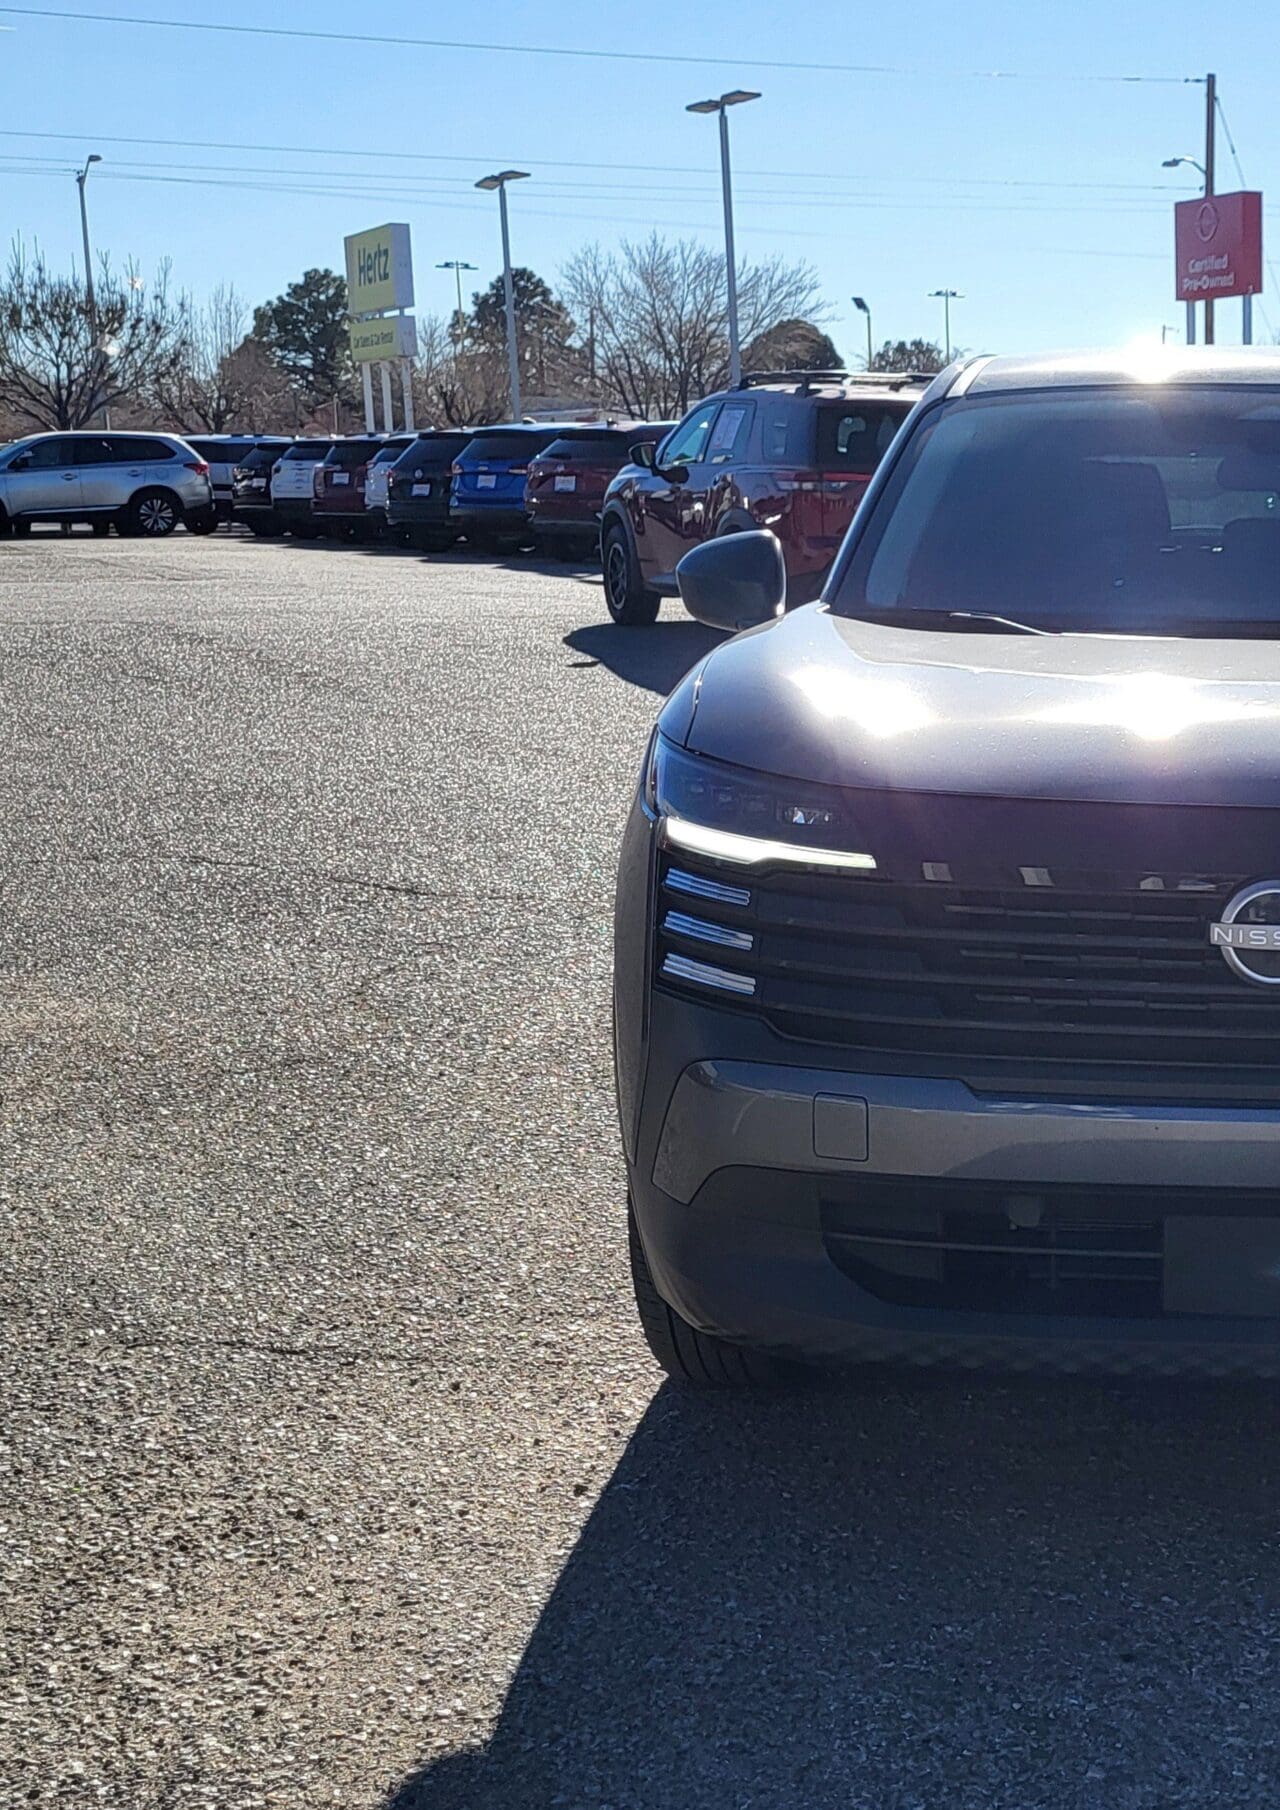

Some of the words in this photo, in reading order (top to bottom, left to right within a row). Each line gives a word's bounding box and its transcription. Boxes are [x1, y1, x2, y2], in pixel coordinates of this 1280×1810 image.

[357, 243, 390, 287] Hertz
[1188, 253, 1228, 274] Certified
[1183, 271, 1235, 292] Pre-Owned
